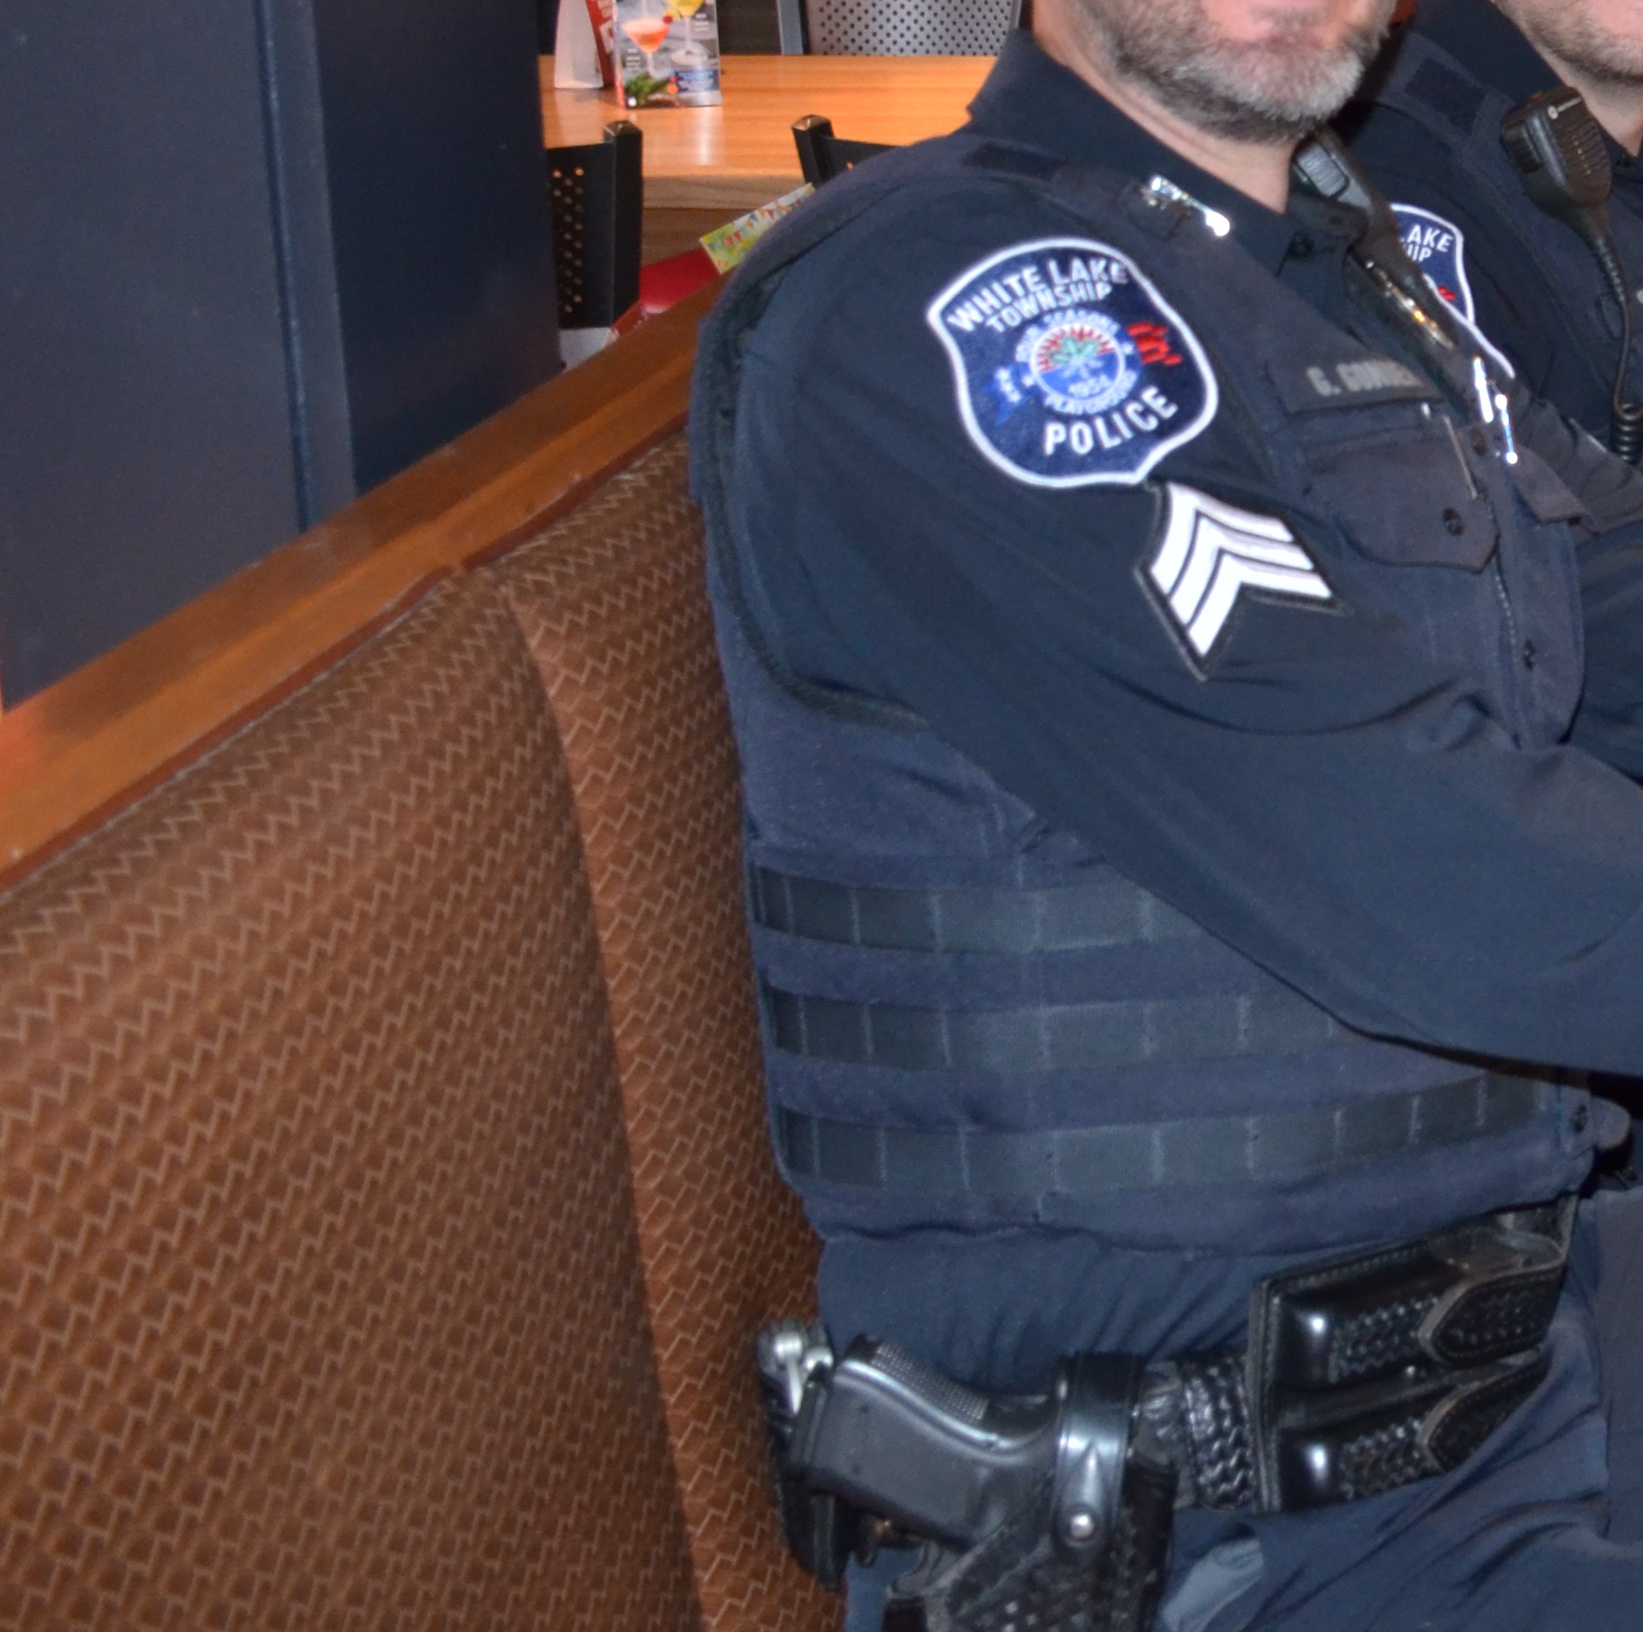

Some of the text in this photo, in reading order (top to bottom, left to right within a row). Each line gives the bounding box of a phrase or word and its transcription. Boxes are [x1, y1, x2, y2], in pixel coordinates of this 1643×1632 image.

[947, 258, 1129, 332] WHITE LAKE
[985, 279, 1113, 333] TOWNSHIP
[1043, 385, 1179, 456] POLICE
